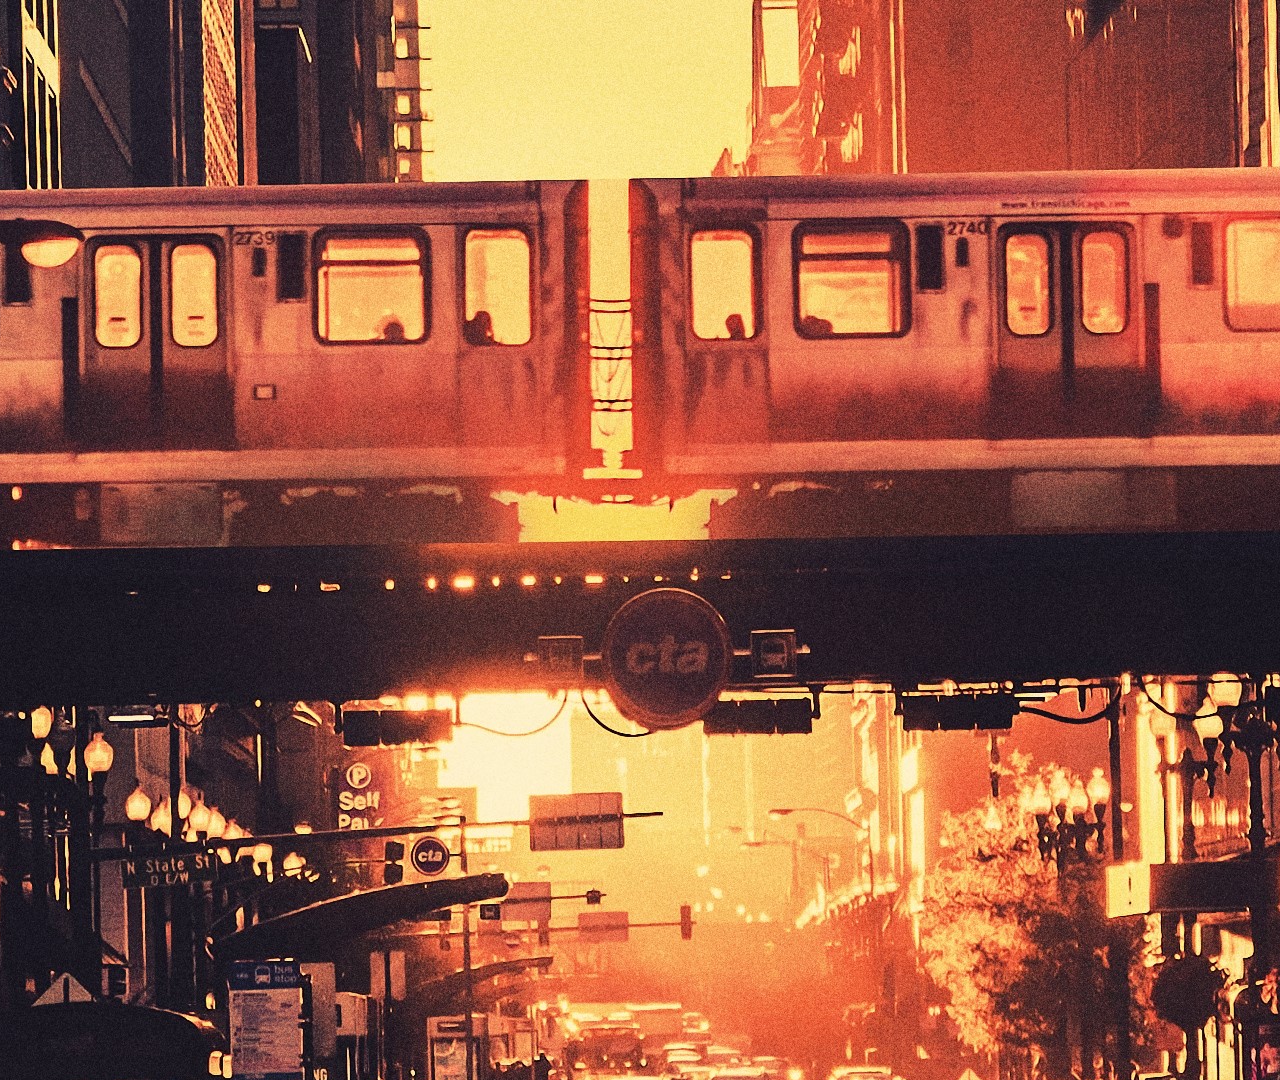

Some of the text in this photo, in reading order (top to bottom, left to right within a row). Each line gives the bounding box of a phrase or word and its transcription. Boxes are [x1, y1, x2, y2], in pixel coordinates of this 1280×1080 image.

[235, 231, 275, 245] 2739
[626, 634, 709, 674] cta
[338, 791, 380, 811] Self
[126, 853, 210, 875] N State St
[417, 850, 443, 863] cta
